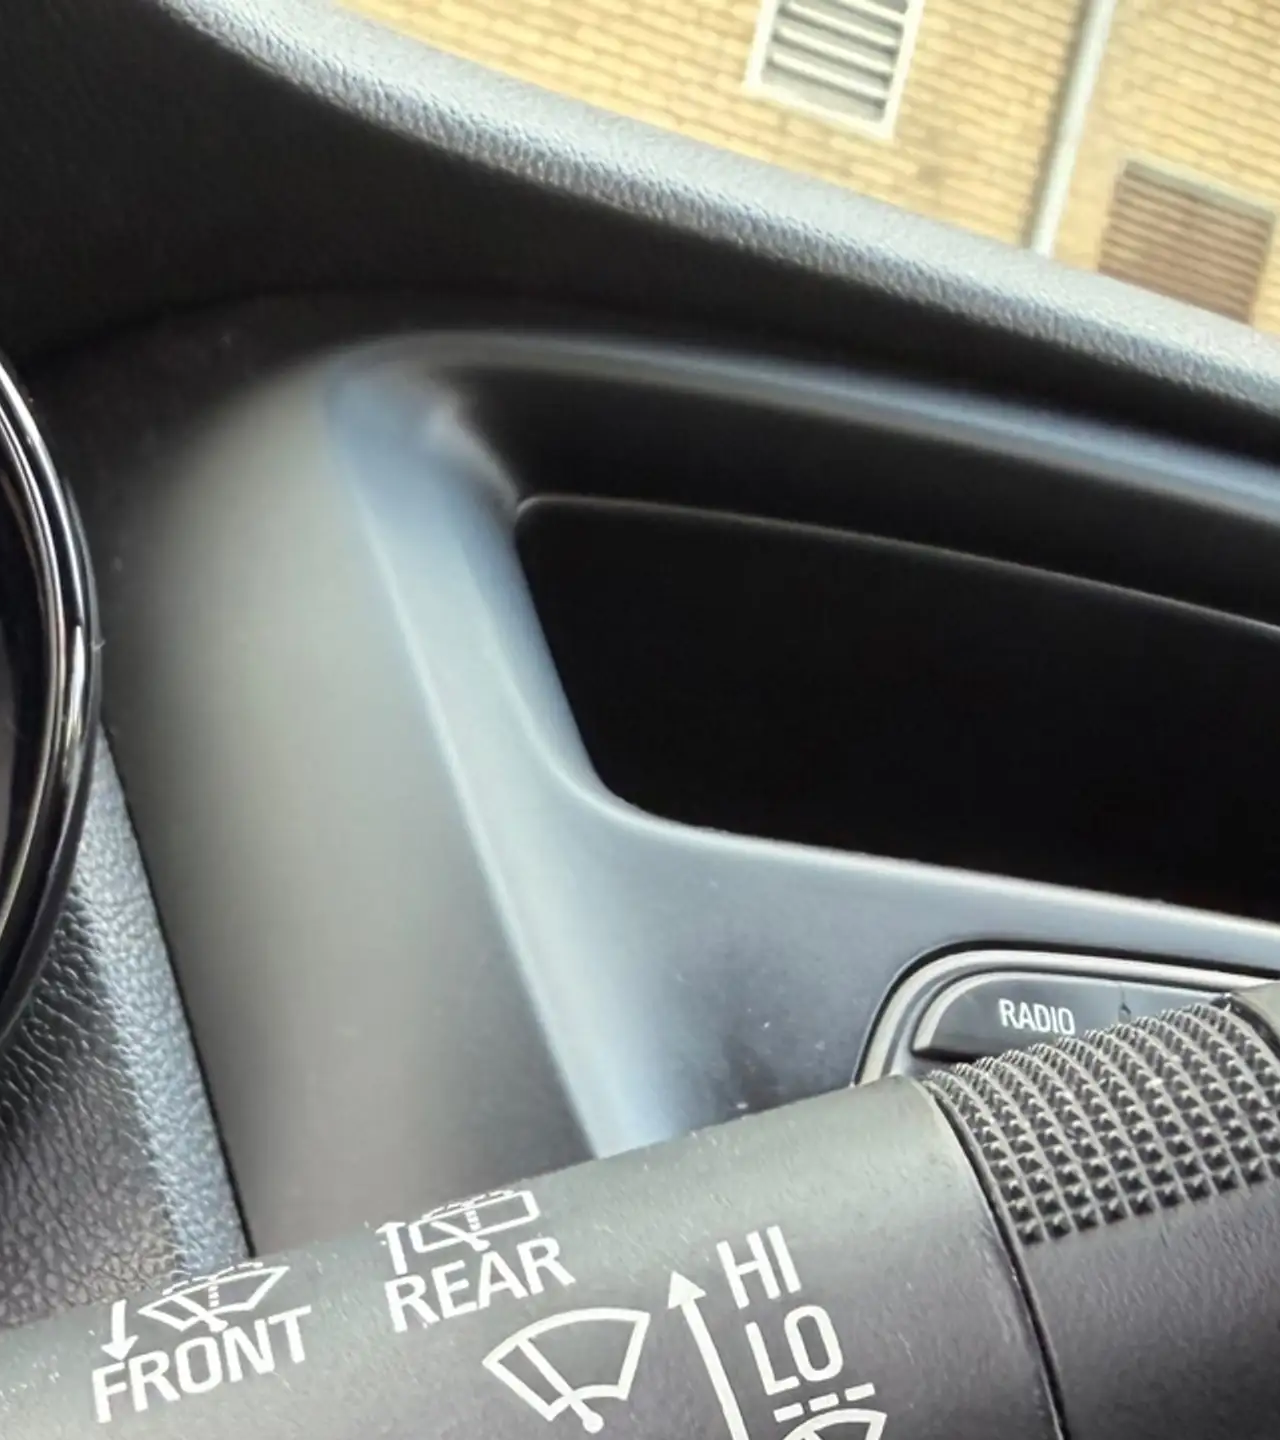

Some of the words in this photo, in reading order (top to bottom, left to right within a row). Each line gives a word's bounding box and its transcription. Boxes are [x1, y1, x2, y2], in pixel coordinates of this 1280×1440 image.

[998, 997, 1076, 1037] RADIO
[383, 1235, 577, 1334] REAR
[716, 1225, 801, 1310] HI
[90, 1304, 313, 1424] FRONT
[744, 1303, 845, 1397] LO
